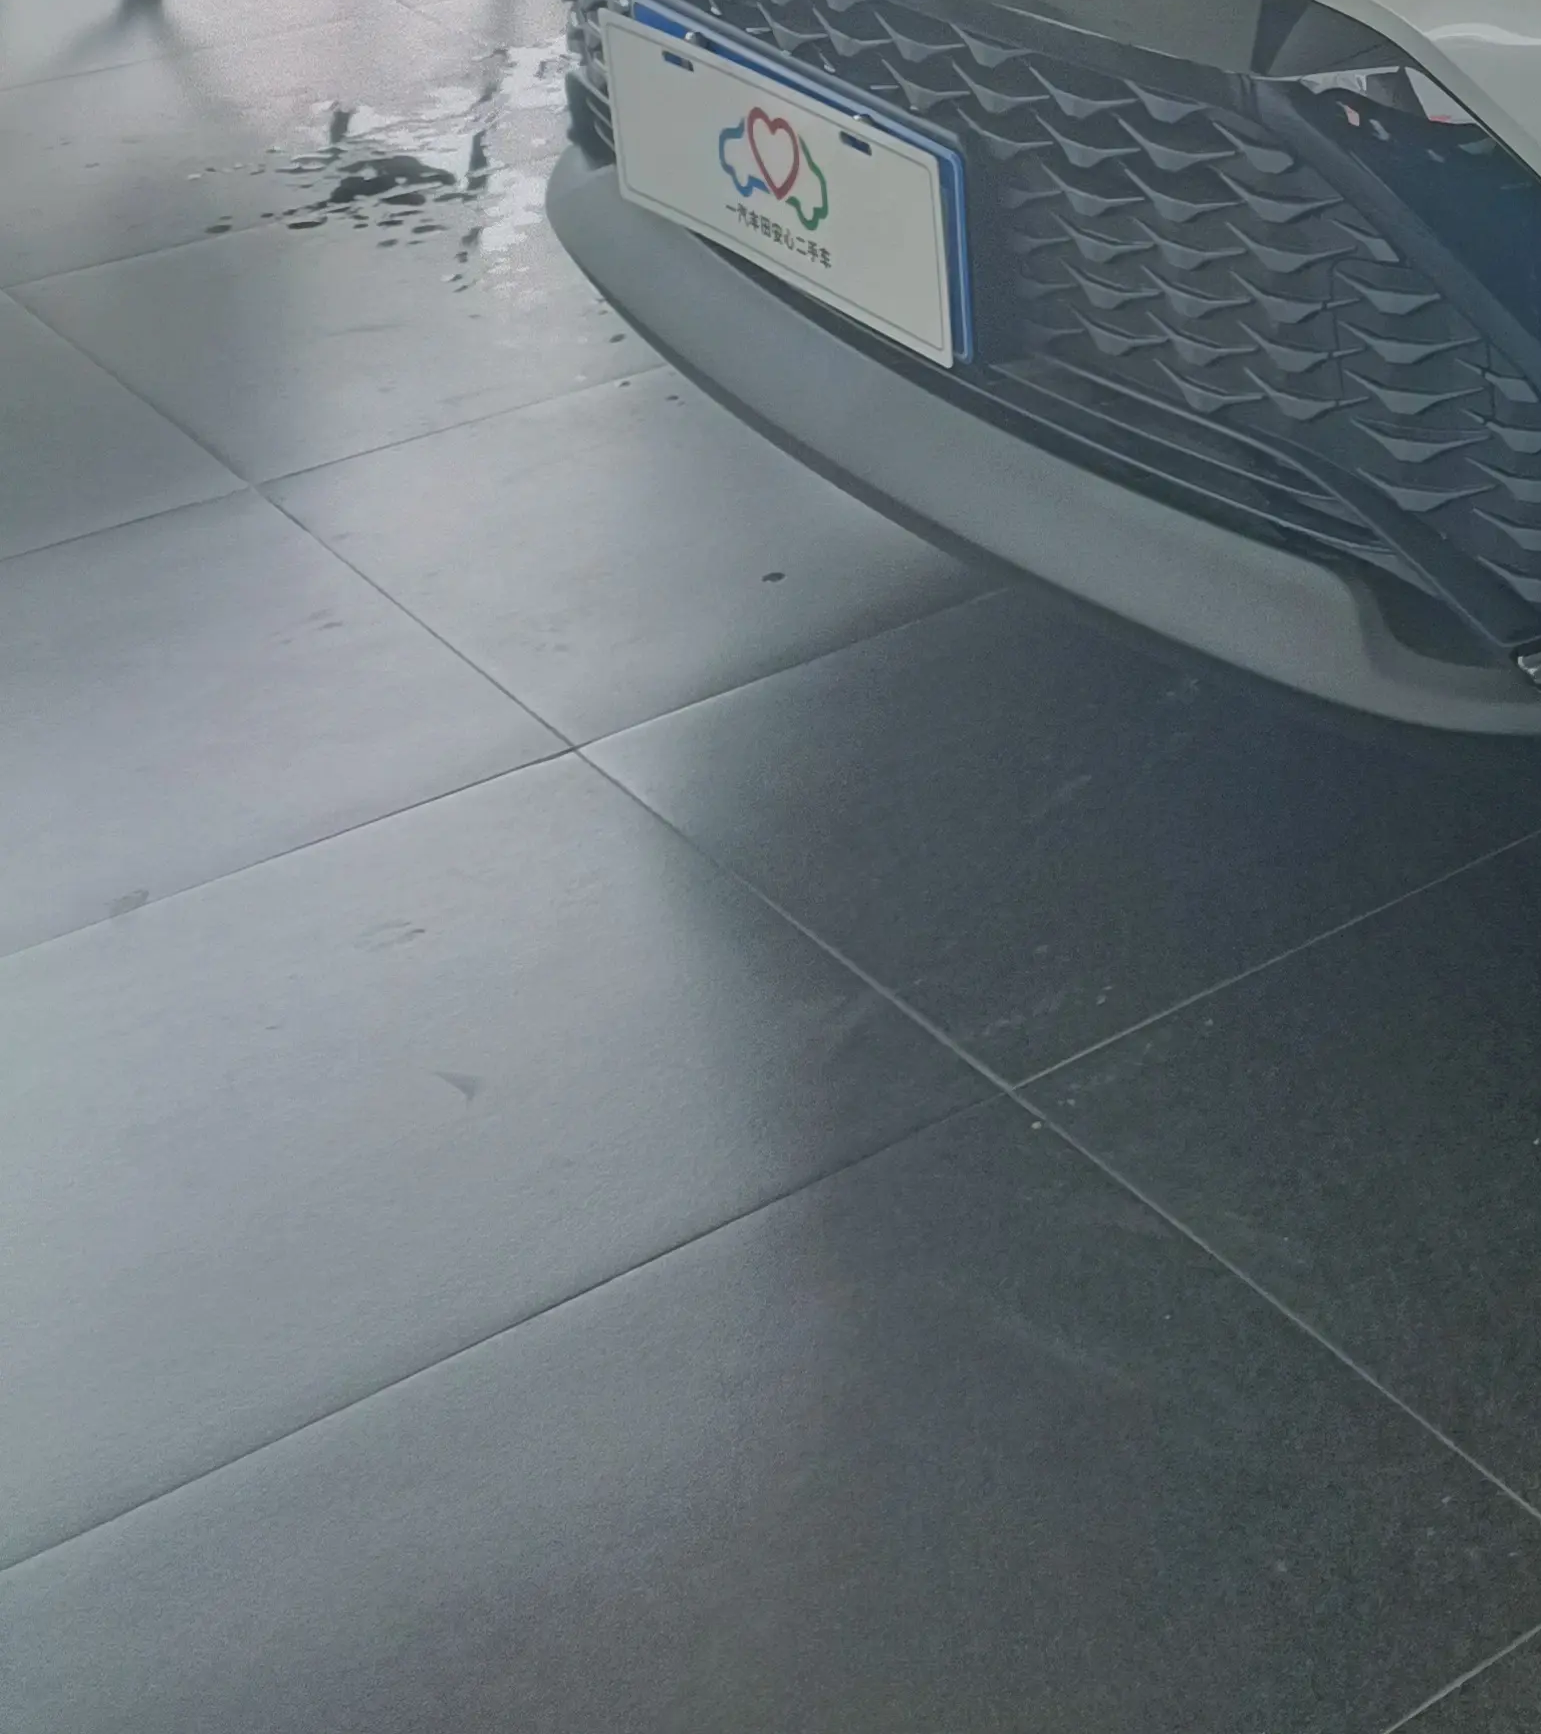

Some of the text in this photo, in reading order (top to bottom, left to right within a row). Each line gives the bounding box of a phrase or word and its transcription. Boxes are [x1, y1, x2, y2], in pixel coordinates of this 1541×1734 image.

[725, 202, 832, 269] 一汽丰田安心二手车
